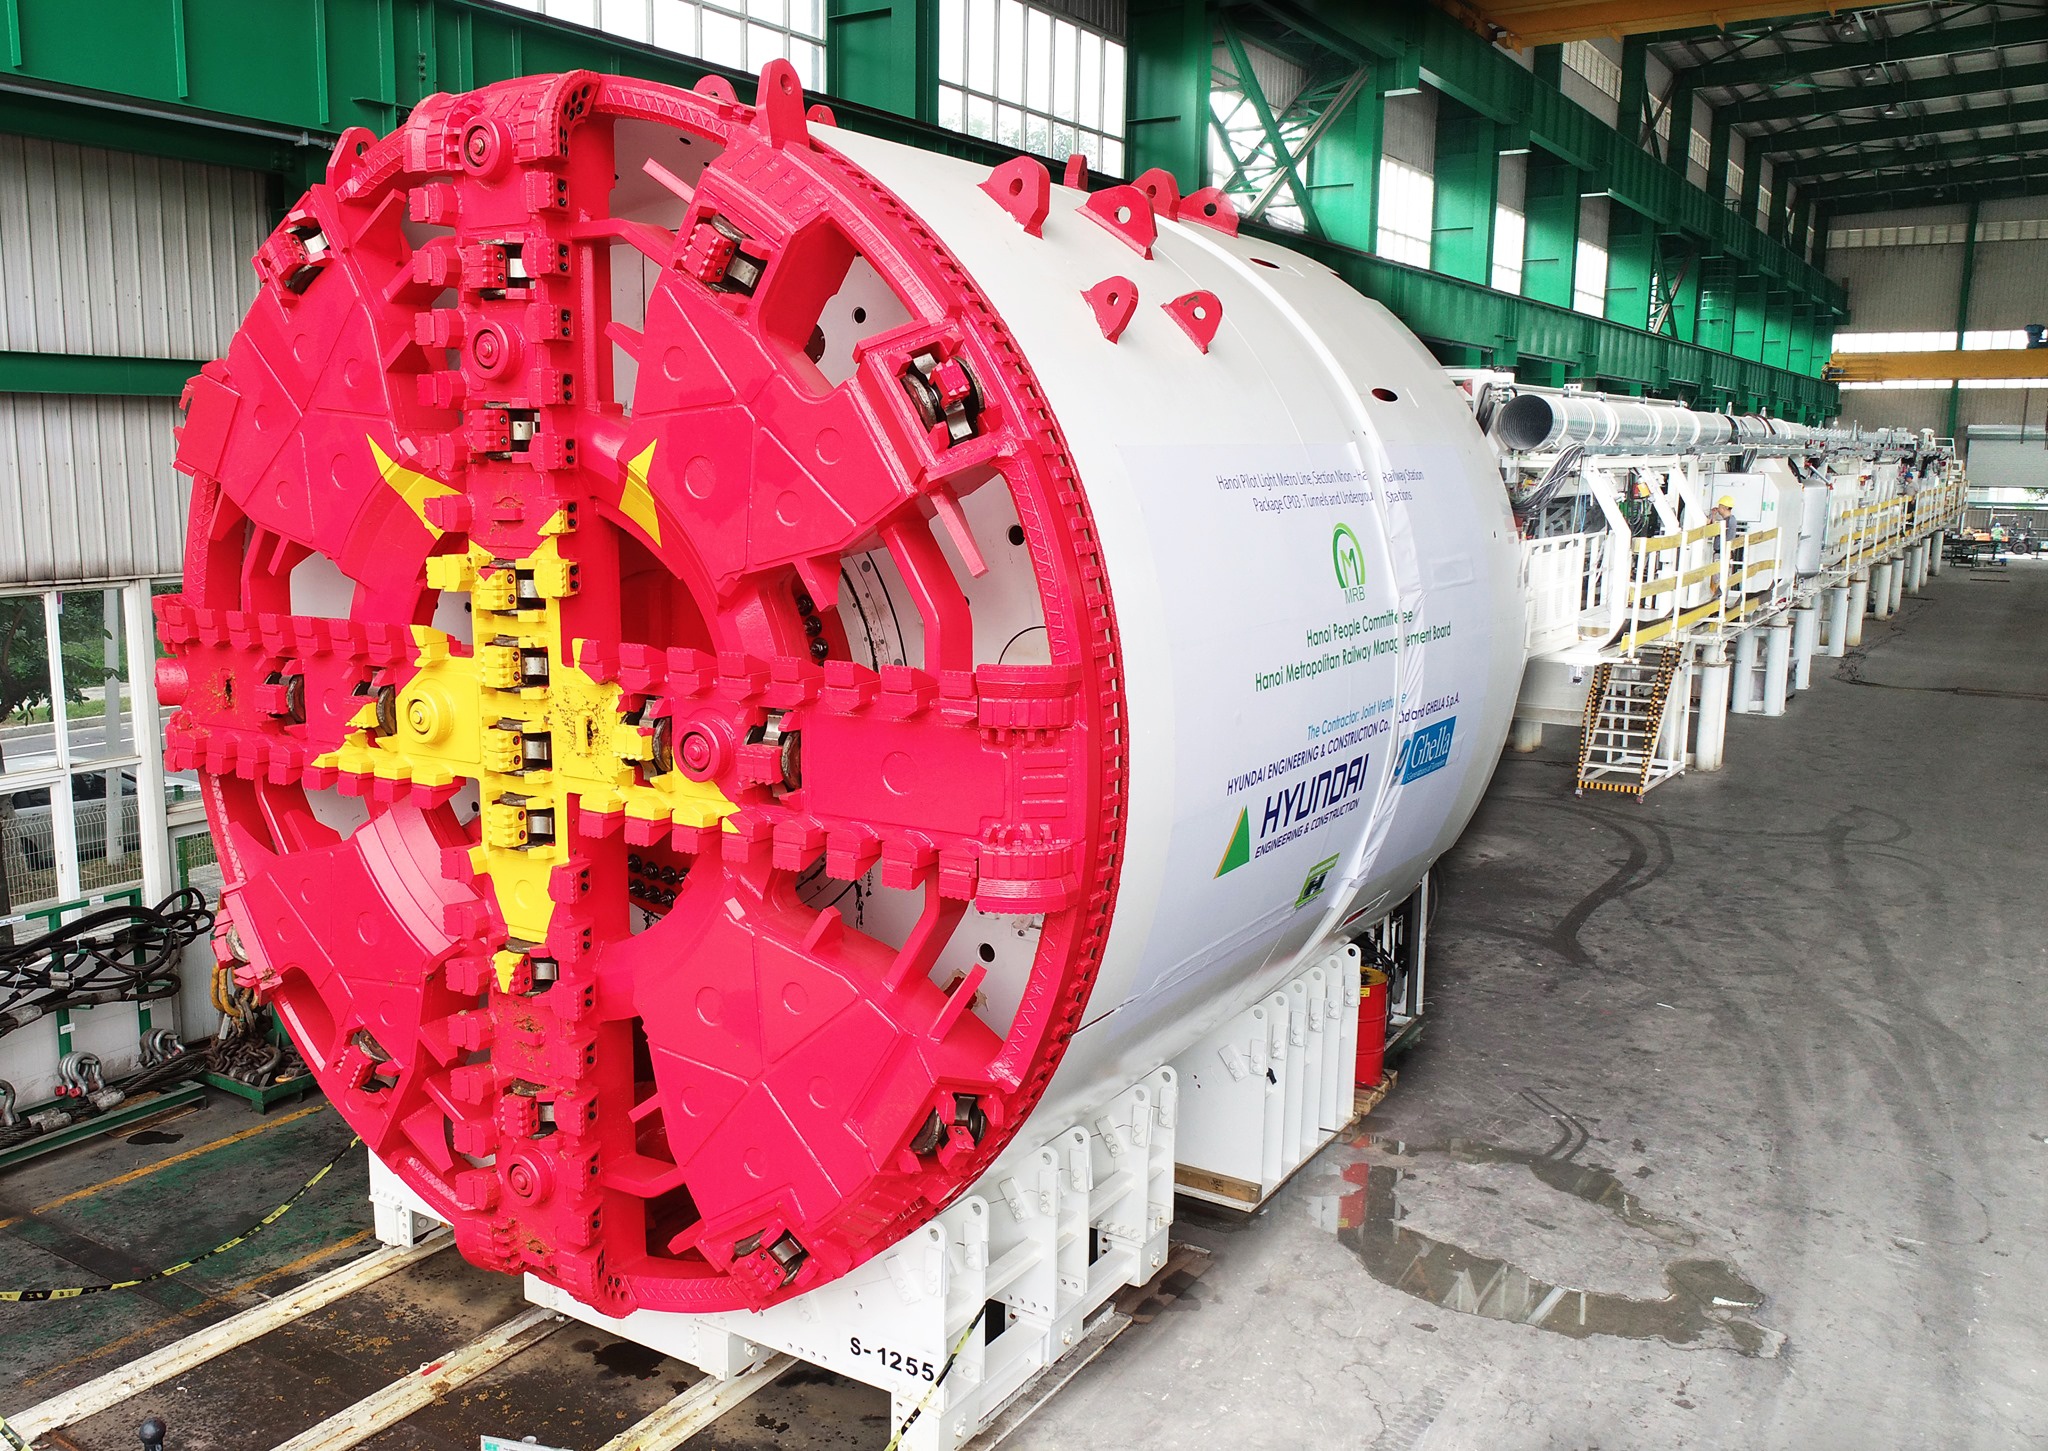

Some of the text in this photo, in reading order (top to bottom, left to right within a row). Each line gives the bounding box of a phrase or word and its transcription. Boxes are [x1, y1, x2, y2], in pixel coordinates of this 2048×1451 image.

[1216, 474, 1240, 490] Hanoi
[1240, 473, 1259, 489] Pilot
[1257, 472, 1276, 491] Light
[1276, 472, 1298, 487] Metro
[1312, 470, 1337, 485] Section
[1335, 469, 1353, 483] Nhon
[1381, 469, 1407, 484] Railway
[1405, 469, 1425, 481] Station
[1253, 496, 1284, 514] Package
[1303, 491, 1329, 508] Tunnels
[1328, 491, 1341, 505] and
[1385, 489, 1413, 503] Stations
[1344, 586, 1366, 604] MRB
[1306, 624, 1332, 648] Hanoi
[1333, 618, 1361, 641] People
[1255, 666, 1283, 692] Hanoi
[1286, 653, 1341, 683] Metropolitan
[1342, 645, 1372, 666] Railway
[1432, 621, 1451, 640] Board
[1307, 693, 1407, 741] The Contractor: Joint Ventue
[1226, 766, 1266, 796] HYUNDAI
[1267, 746, 1319, 780] ENGINEERING
[1320, 743, 1326, 758] &
[1327, 721, 1379, 755] CONSTRUCTION
[1411, 704, 1426, 720] and
[1426, 697, 1445, 716] GHELLA
[1411, 725, 1451, 769] Ghella
[1260, 752, 1370, 839] HYUNDAI
[1254, 798, 1360, 859] ENGINEERING & CONSTRUCTION
[850, 1337, 935, 1382] S-1255
